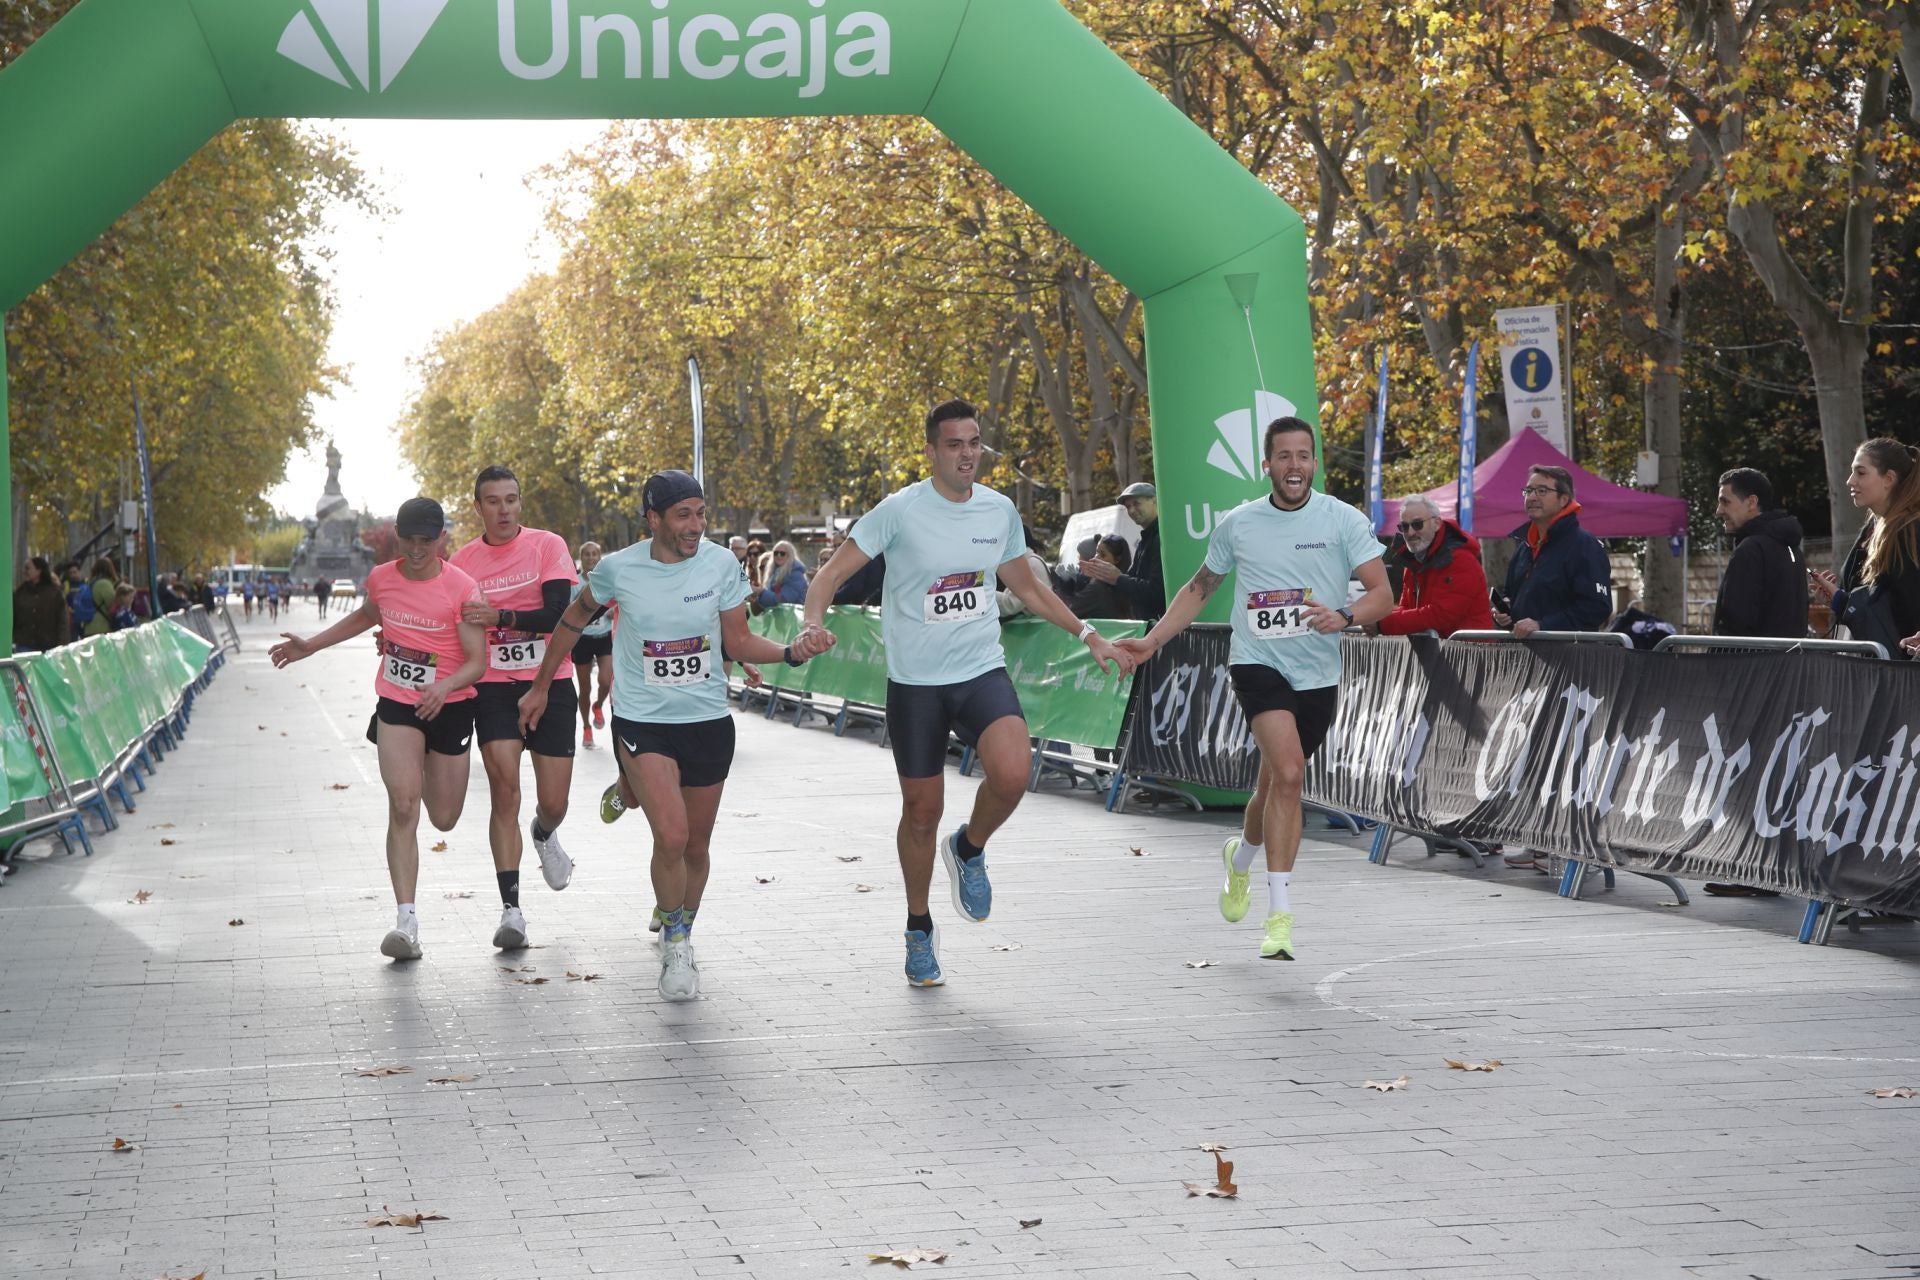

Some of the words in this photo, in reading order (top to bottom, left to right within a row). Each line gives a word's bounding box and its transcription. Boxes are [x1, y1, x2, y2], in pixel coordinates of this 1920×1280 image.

[497, 0, 891, 98] Unicaja
[1504, 316, 1530, 326] Oficina
[1531, 315, 1541, 323] de
[1505, 325, 1550, 335] rmación
[1295, 542, 1326, 550] OneHealth
[934, 590, 977, 615] 840
[1257, 608, 1300, 630] 841
[498, 643, 536, 662] 361
[390, 658, 426, 683] 362
[654, 656, 701, 677] 839
[1540, 682, 1680, 826] Norte
[1680, 713, 1750, 833] de
